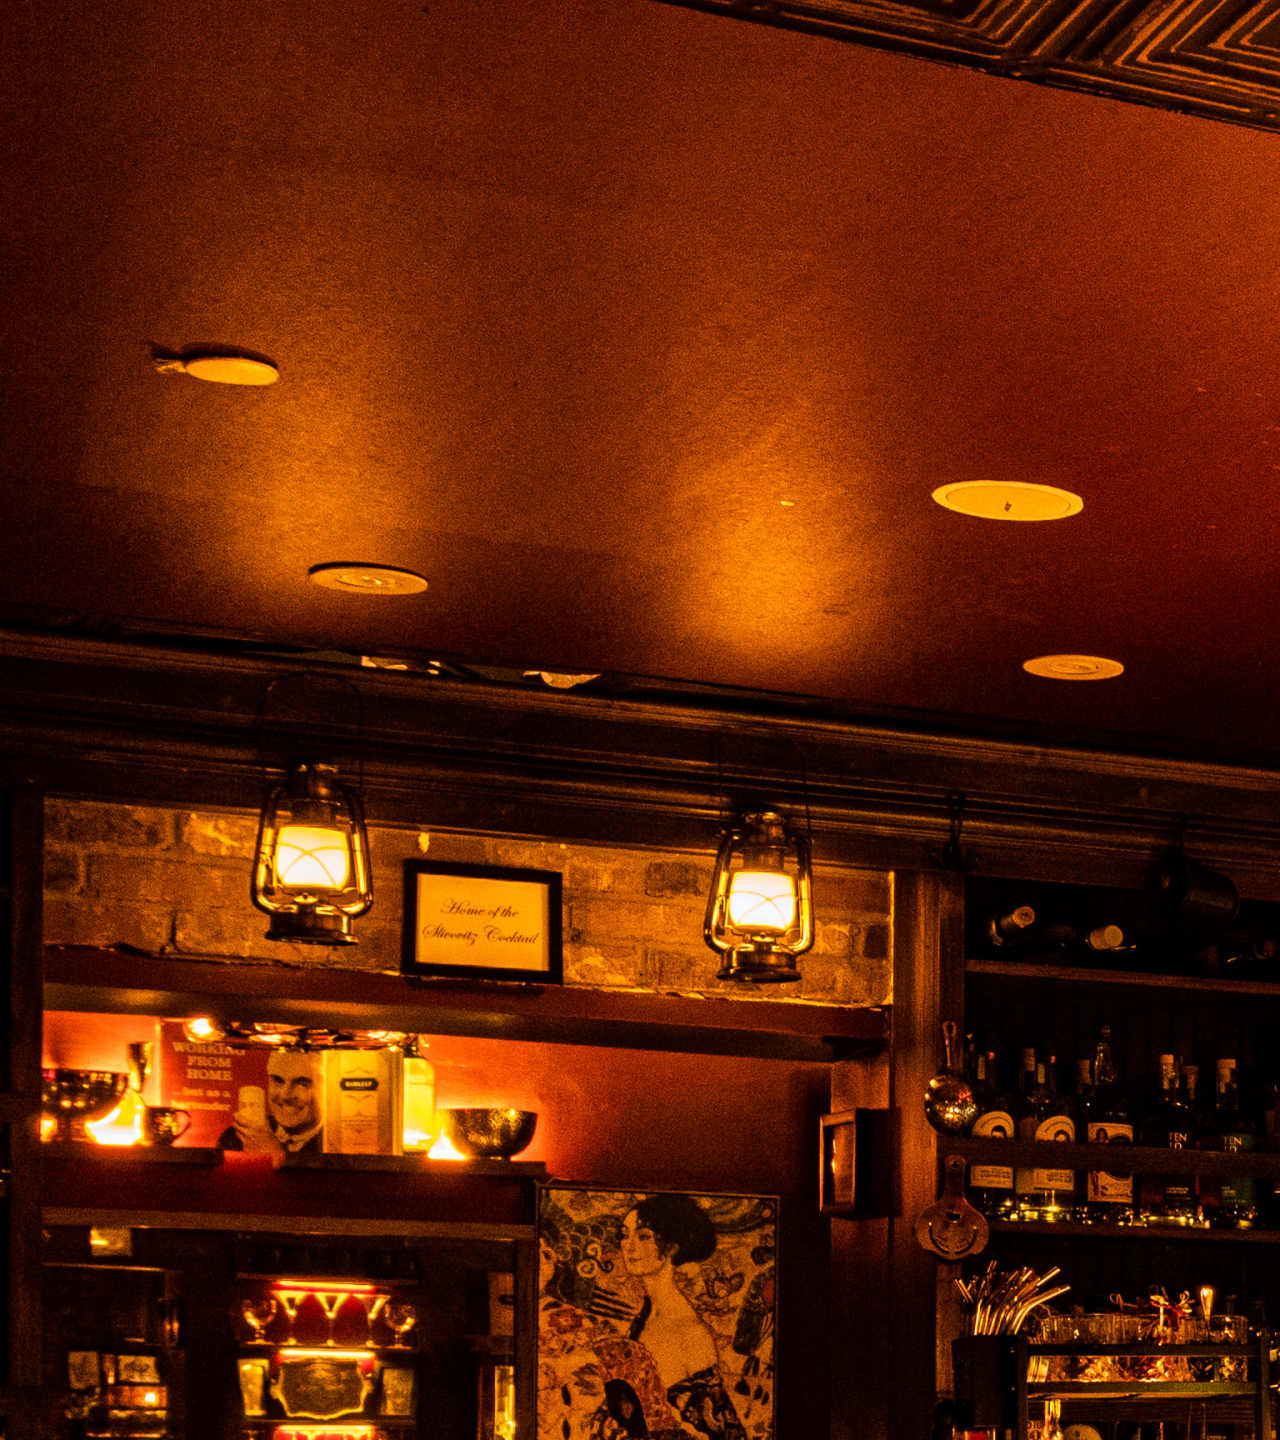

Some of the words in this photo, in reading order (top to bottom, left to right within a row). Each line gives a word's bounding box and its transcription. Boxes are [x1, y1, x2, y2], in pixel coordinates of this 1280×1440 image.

[487, 905, 501, 919] of
[501, 906, 519, 918] the
[187, 1055, 233, 1067] FROM
[187, 1069, 233, 1081] HOME
[1168, 1132, 1188, 1143] TEN
